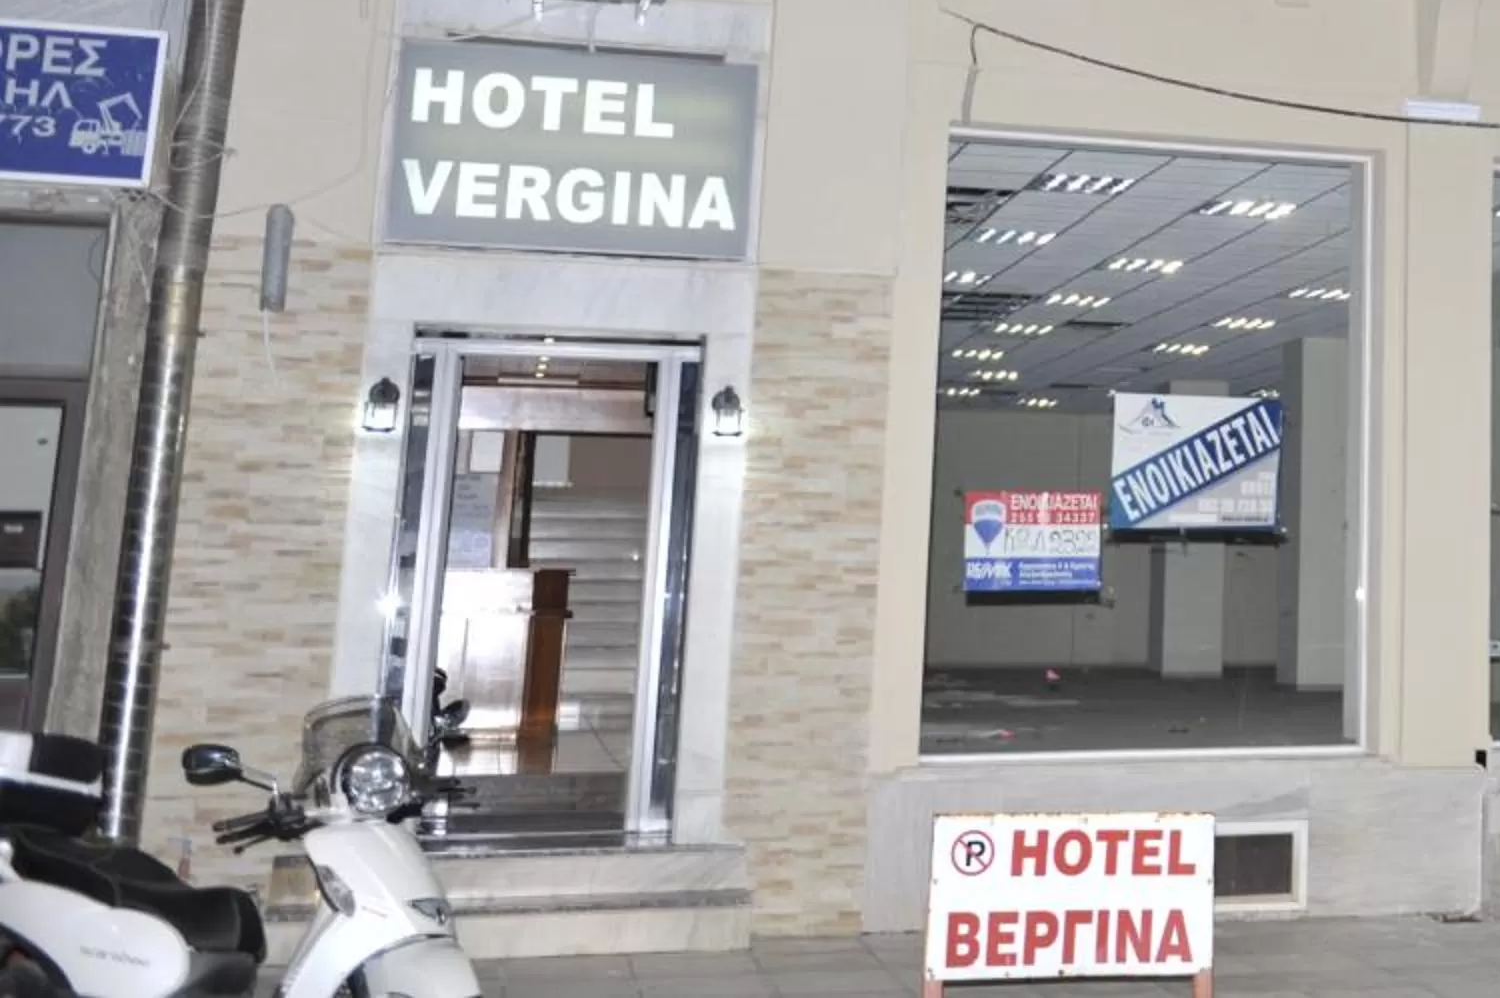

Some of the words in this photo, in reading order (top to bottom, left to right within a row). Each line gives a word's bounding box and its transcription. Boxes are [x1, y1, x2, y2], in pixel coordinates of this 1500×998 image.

[0, 33, 108, 77] ΡΕΣ
[0, 78, 73, 109] ΗΛ
[411, 67, 674, 139] HOTEL
[401, 158, 737, 231] VERGINA
[1112, 404, 1281, 522] ΕΝΟΙΚΙΑΖΕΤΑΙ
[1010, 492, 1098, 511] ΕΝΟΙΙΑΖΕΤΑΙ
[1010, 829, 1196, 877] HOTEL
[945, 909, 1194, 969] ΒΕΡΓΙΝΑ
